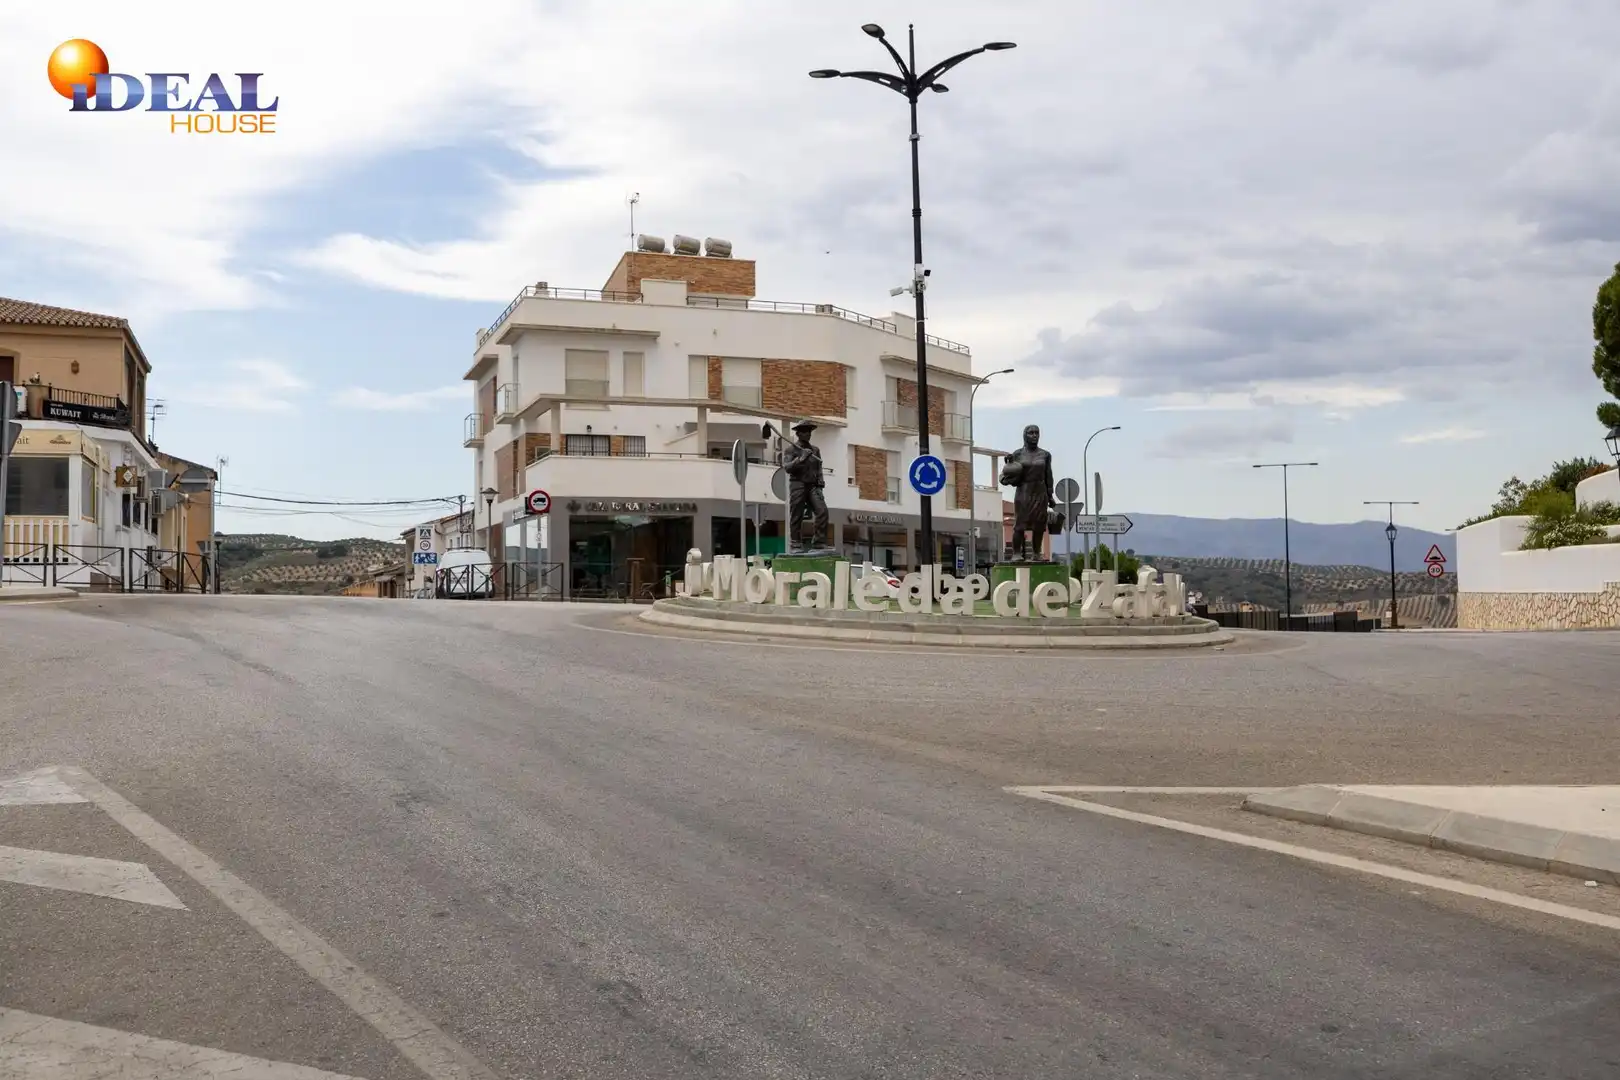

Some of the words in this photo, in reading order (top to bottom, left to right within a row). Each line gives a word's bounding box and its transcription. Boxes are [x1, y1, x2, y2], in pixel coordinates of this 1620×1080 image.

[50, 407, 82, 419] KUWAIT
[713, 555, 974, 615] Moraleda
[992, 567, 1069, 618] de
